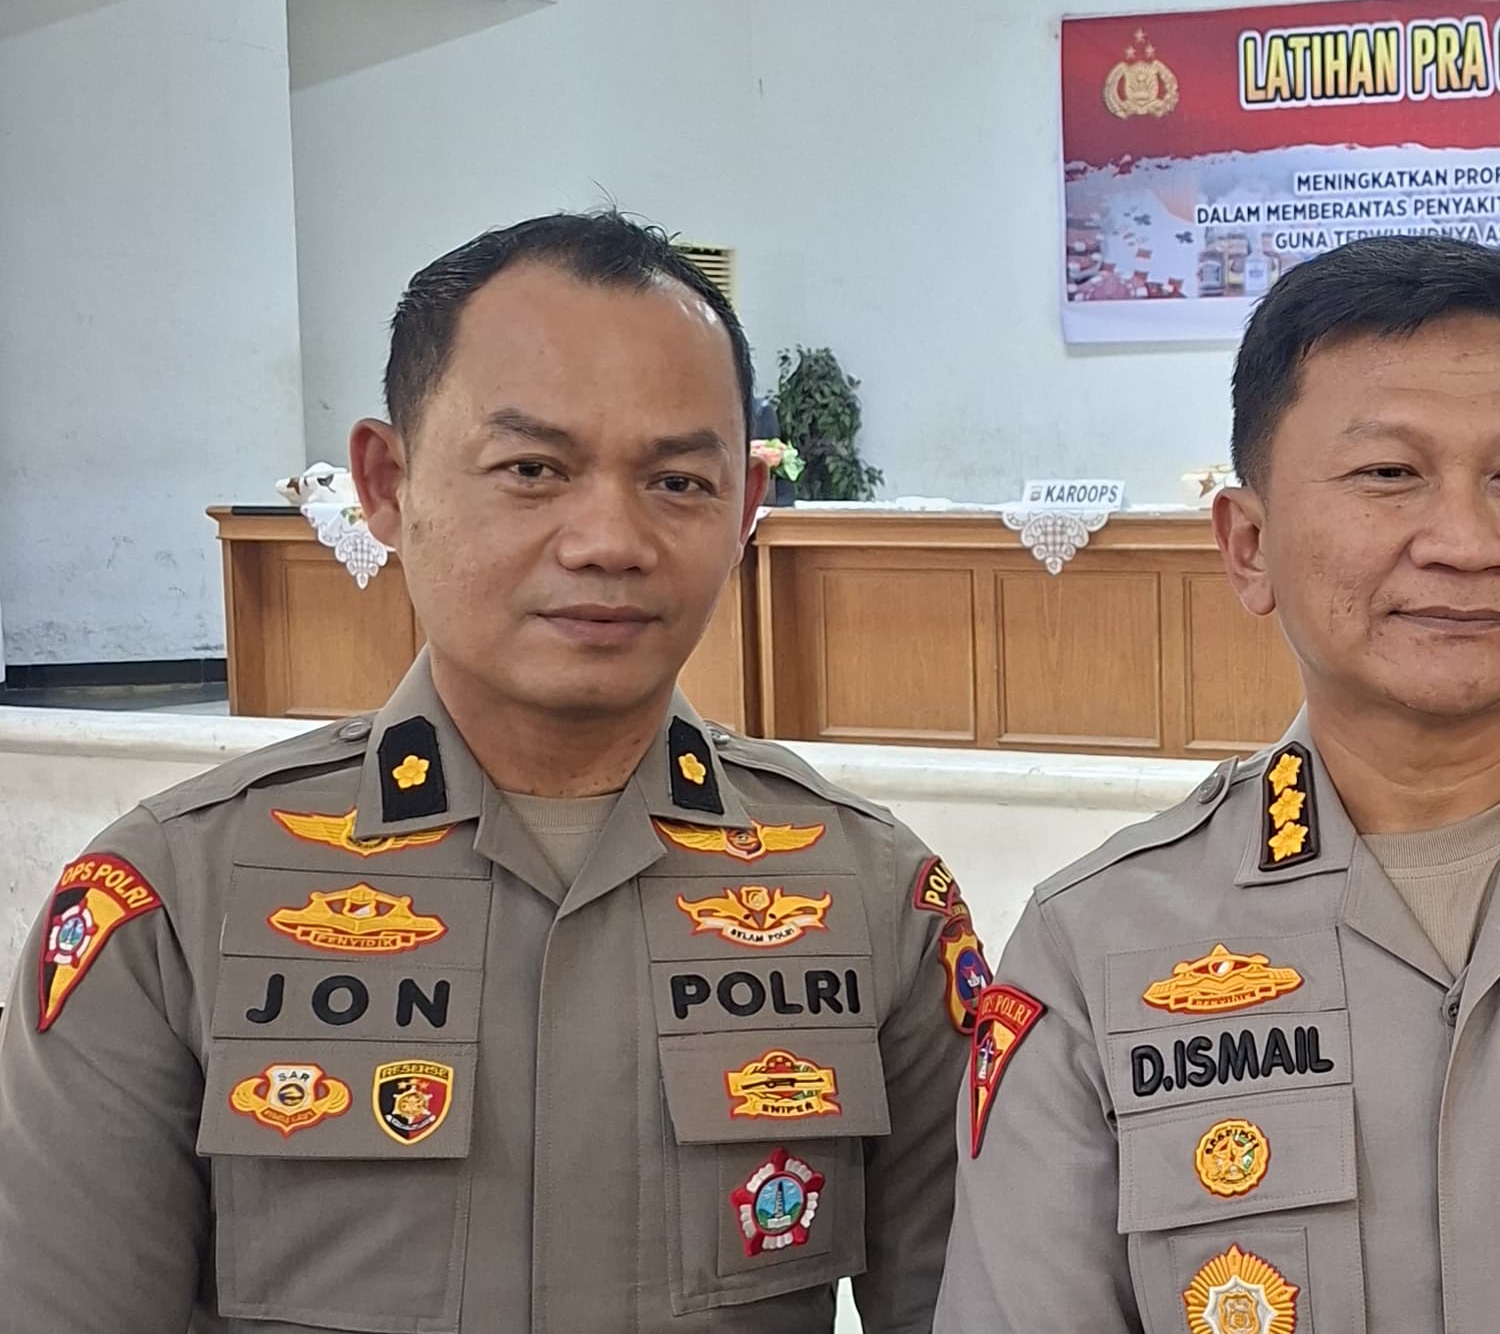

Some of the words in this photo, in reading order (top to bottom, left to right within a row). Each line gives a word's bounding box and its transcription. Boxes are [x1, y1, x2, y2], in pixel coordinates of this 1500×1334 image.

[1243, 27, 1399, 103] LATIHAN
[1412, 20, 1489, 93] PRA
[1297, 169, 1448, 192] MENINGKATKAN
[1197, 205, 1260, 224] DALAM
[1267, 198, 1407, 222] MEMBERANTAS
[1275, 230, 1327, 249] GUNA
[61, 861, 96, 887] OPS
[92, 864, 154, 909] POLRI
[246, 973, 451, 1028] JON
[670, 969, 861, 1020] POLRI
[994, 994, 1033, 1026] POLRI
[278, 1071, 310, 1084] SAR
[1131, 1026, 1334, 1098] D.ISMAIL
